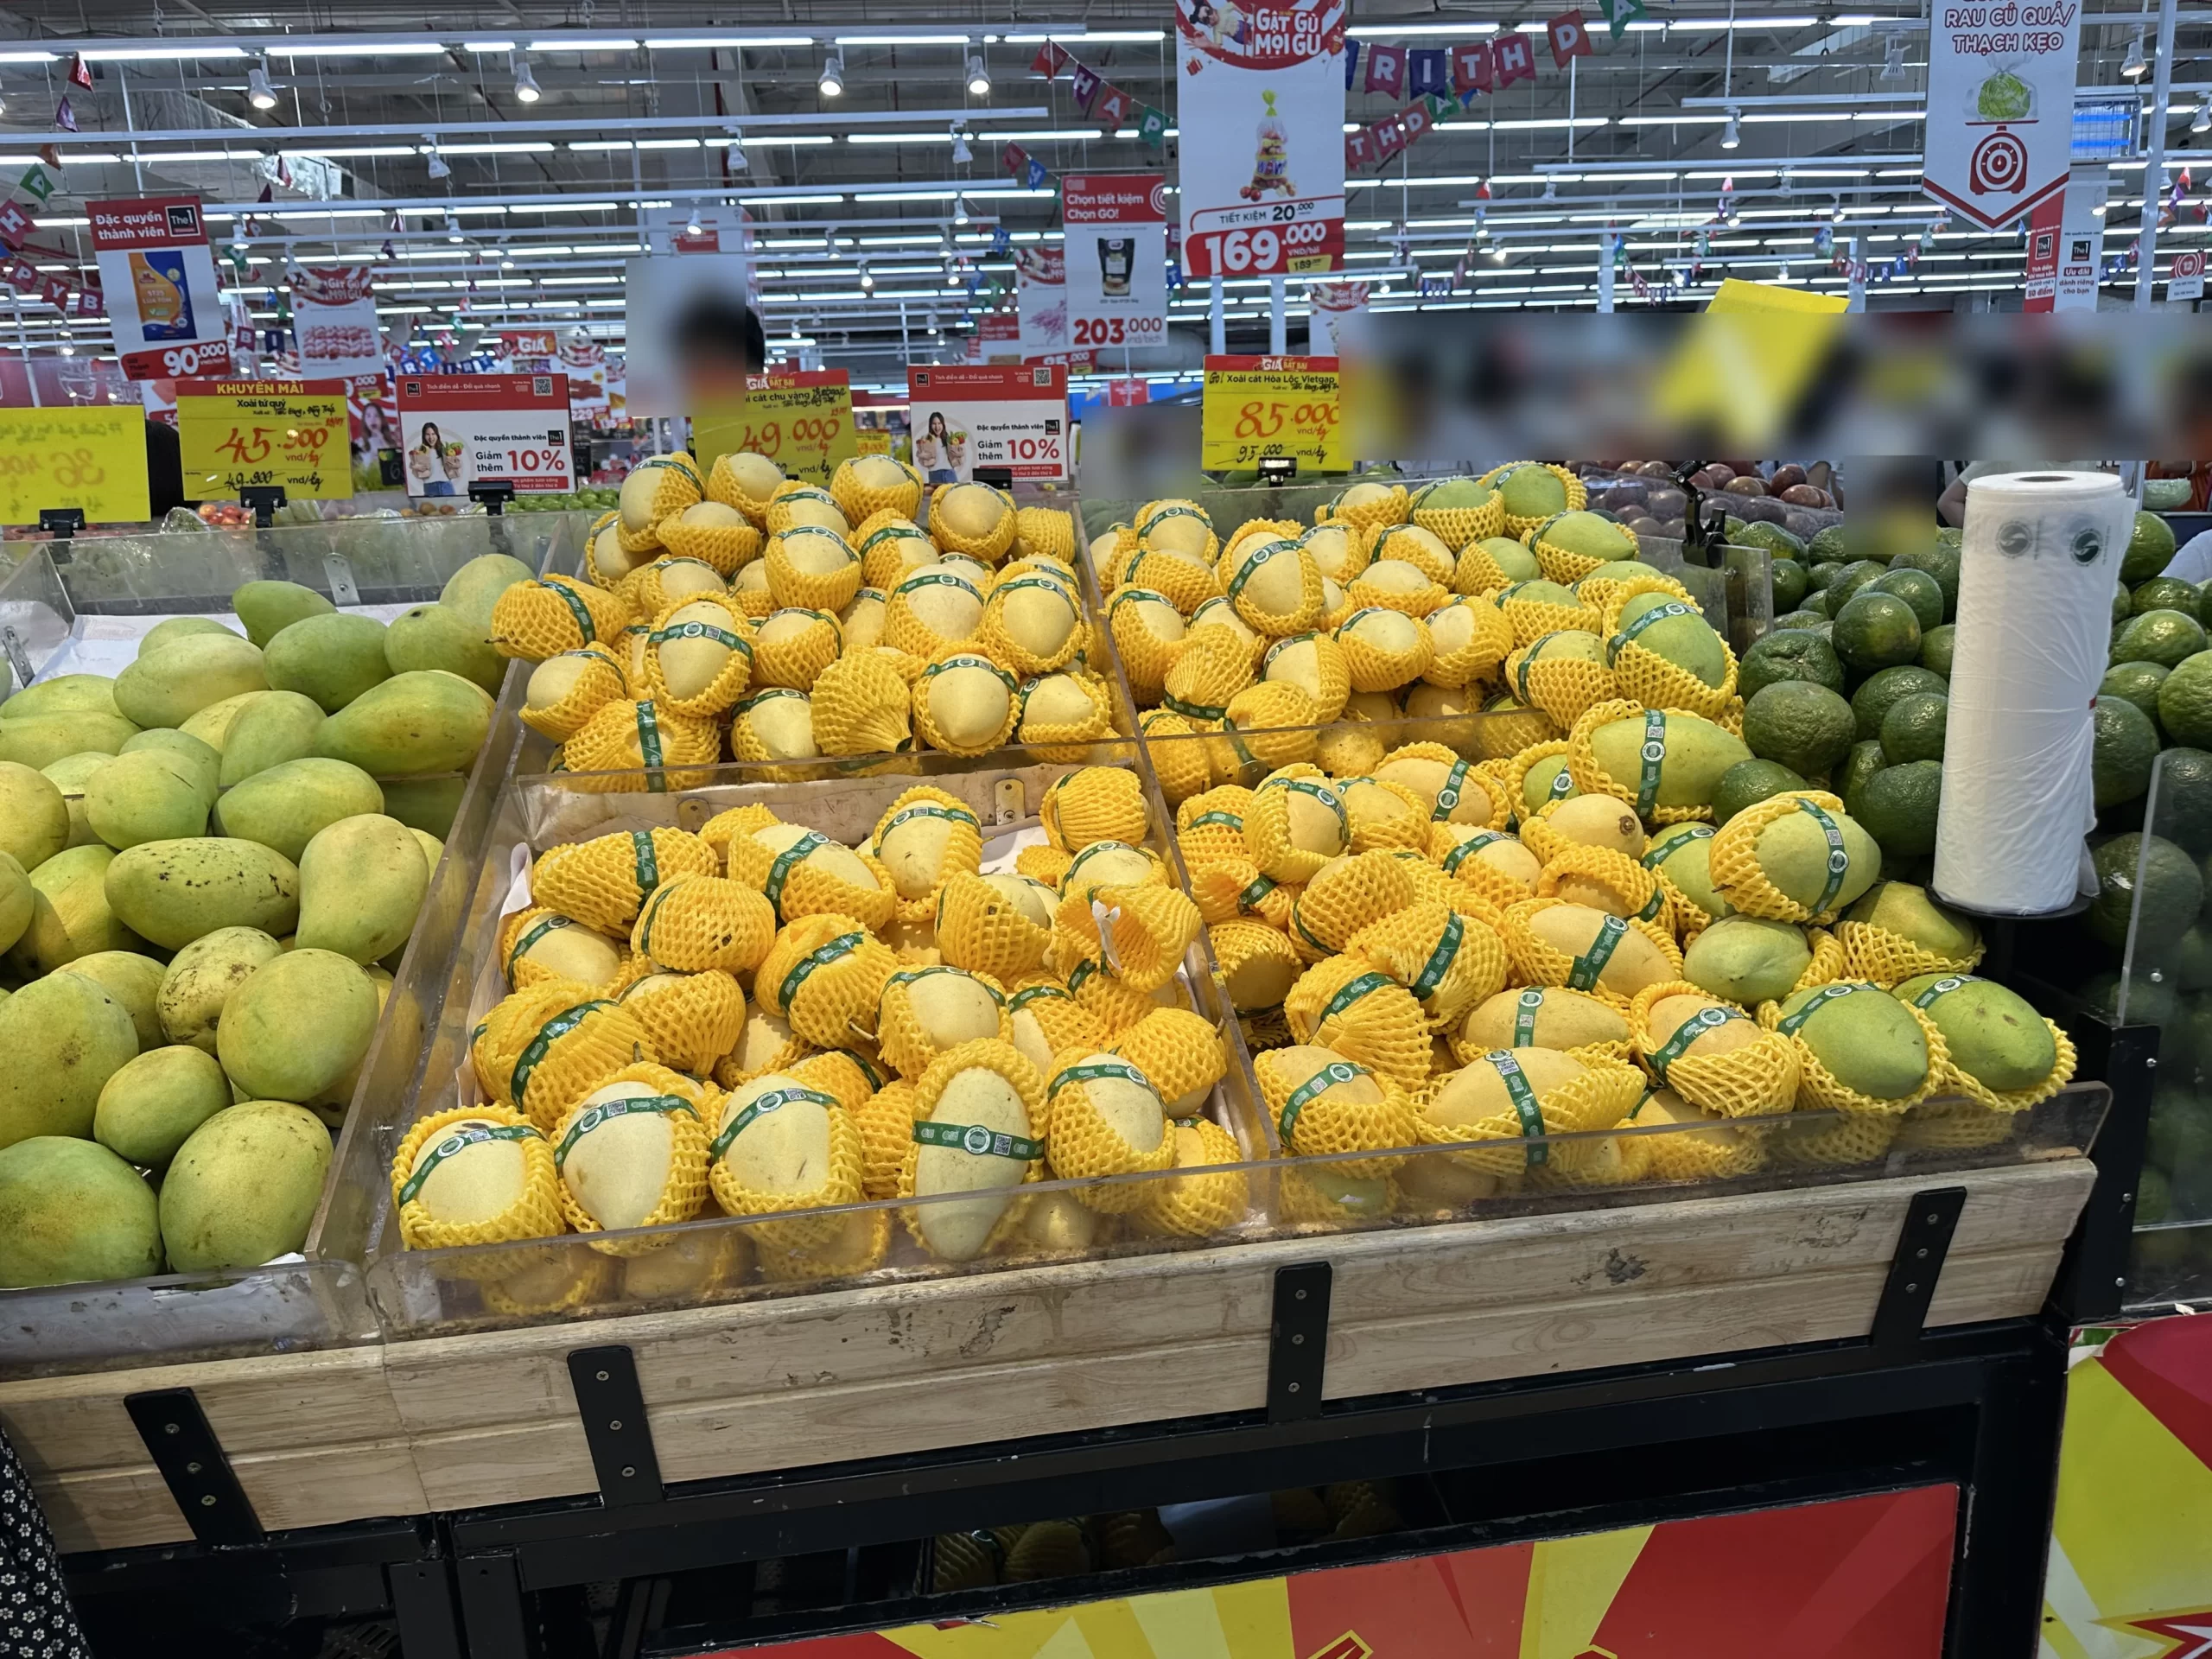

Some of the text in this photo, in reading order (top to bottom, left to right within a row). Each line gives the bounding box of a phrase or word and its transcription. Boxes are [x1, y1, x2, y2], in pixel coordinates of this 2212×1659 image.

[1256, 8, 1319, 34] GẬT GÙ
[1945, 0, 2076, 28] RAU CỦ QUẢ/
[1255, 33, 1321, 56] MỌI GU
[1952, 32, 2063, 56] THẠCH KẸO
[1066, 193, 1143, 207] Chọn tiết kiệm
[96, 210, 162, 227] Đặc quyền
[1067, 209, 1119, 220] Chọn GO!
[1219, 212, 1240, 224] TIẾT
[1243, 211, 1267, 223] KIỆM
[99, 226, 165, 241] thành viên
[1227, 374, 1247, 383] Xoài
[1249, 374, 1262, 383] cát
[1264, 374, 1281, 383] Hòa
[1284, 373, 1298, 384] Lộc
[1301, 374, 1335, 385] Vietgap
[217, 380, 304, 394] KHUYẾN MÃI
[770, 392, 785, 401] chu
[788, 391, 810, 400] vàng
[237, 398, 286, 410] Xoài tứ quý
[977, 423, 988, 432] Đặc
[990, 423, 1010, 432] quyền
[1011, 423, 1028, 431] thành
[488, 433, 511, 442] quyền
[978, 438, 1059, 459] Giảm 10%
[476, 449, 565, 471] Giảm 10%
[978, 451, 1003, 461] thêm
[477, 463, 504, 472] thêm
